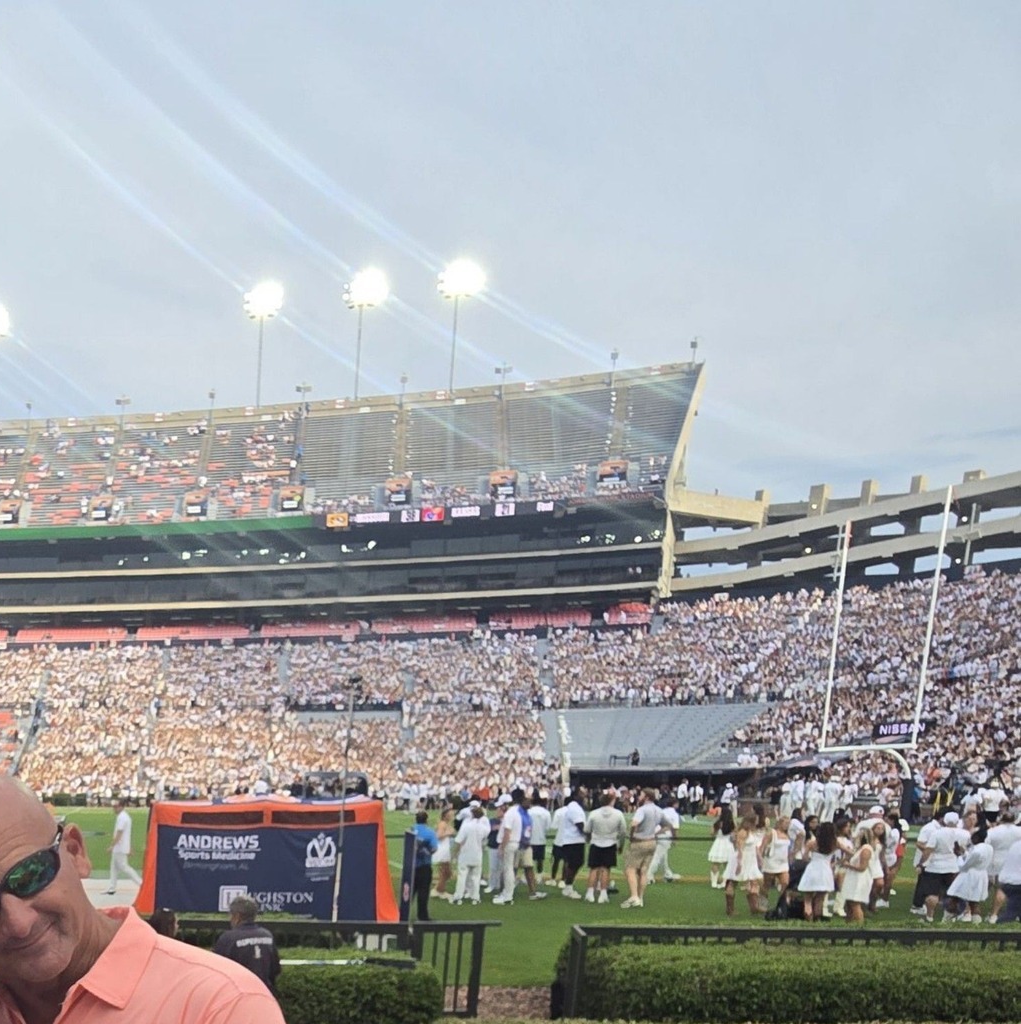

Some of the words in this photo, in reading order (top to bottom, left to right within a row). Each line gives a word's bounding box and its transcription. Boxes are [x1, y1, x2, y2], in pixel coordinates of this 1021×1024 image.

[879, 722, 926, 736] NISSAN
[177, 833, 259, 849] ANDREWS
[178, 849, 210, 861] Sports
[212, 849, 256, 860] Medicine
